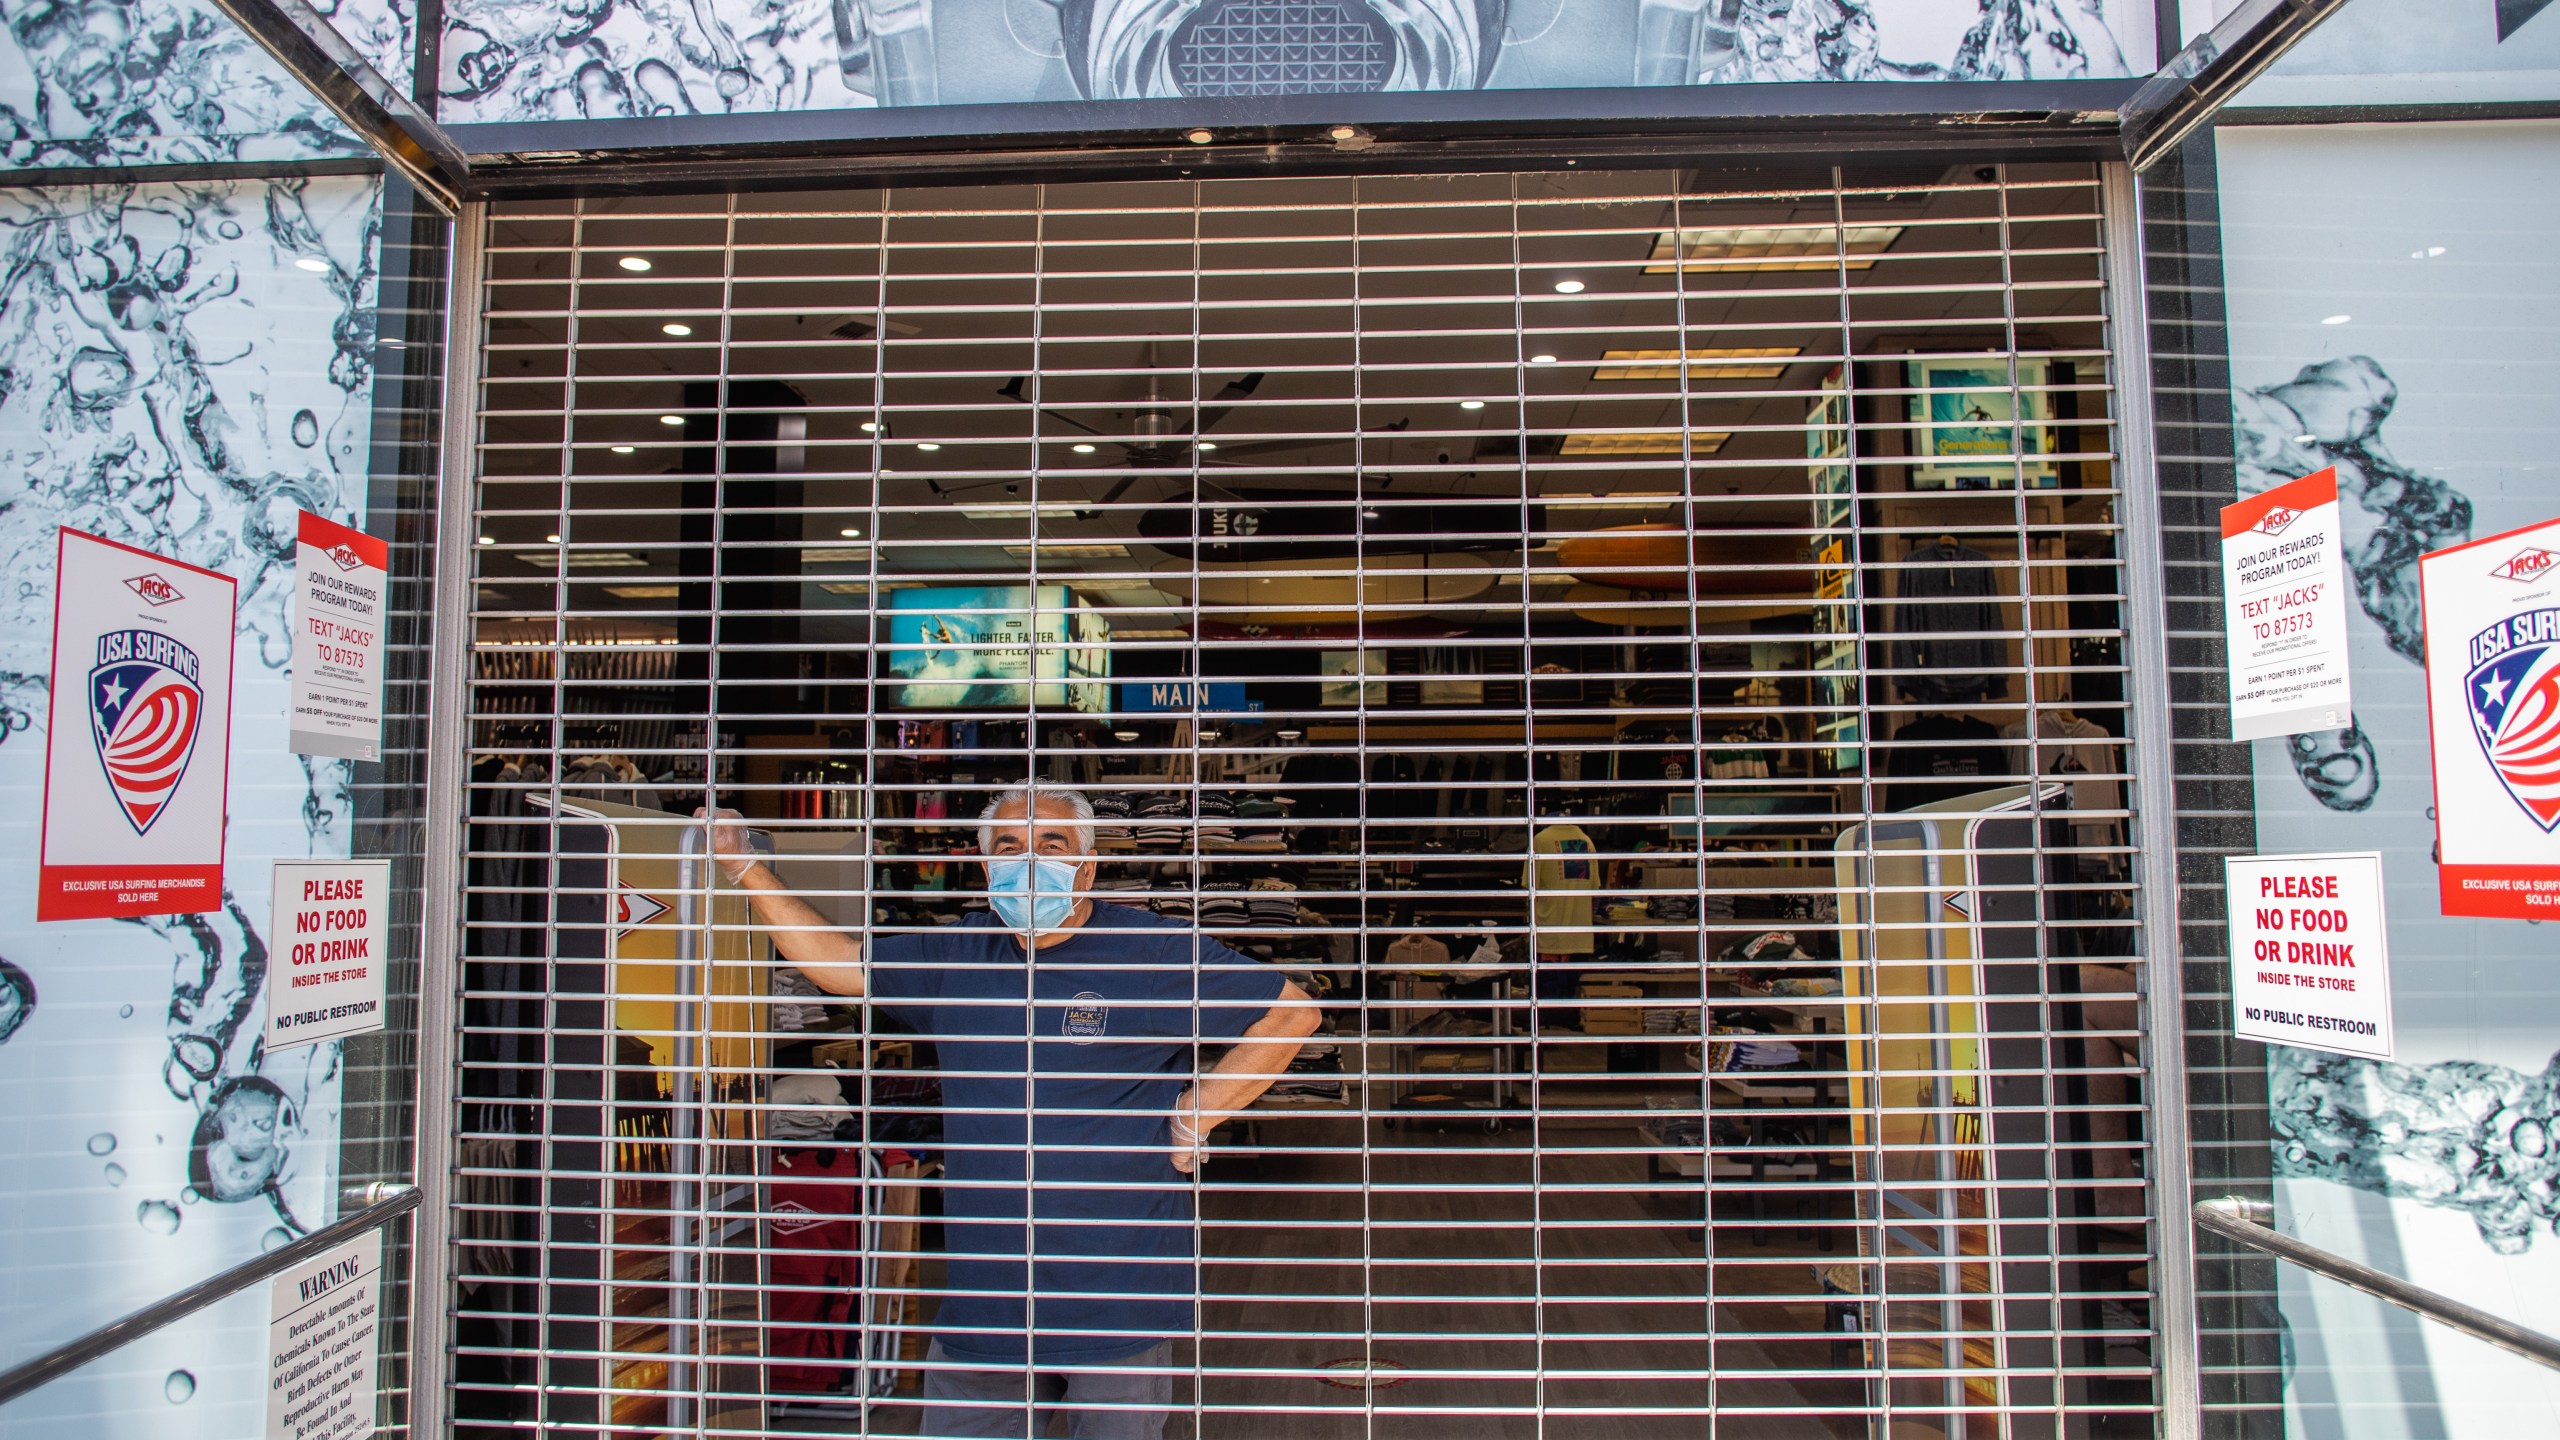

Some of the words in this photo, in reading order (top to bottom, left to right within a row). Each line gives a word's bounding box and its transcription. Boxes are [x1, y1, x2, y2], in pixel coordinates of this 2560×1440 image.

[2261, 509, 2291, 533] JACKS
[2236, 554, 2256, 570] JOIN
[2258, 547, 2277, 563] OUR
[2279, 532, 2324, 557] REWARDS
[2241, 562, 2284, 585] PROGRAM
[2286, 551, 2321, 572] TODAY!
[2507, 550, 2552, 579] JACKS
[139, 576, 170, 598] JACKS
[308, 570, 326, 586] JOIN
[327, 577, 343, 591] OUR
[344, 582, 377, 601] REWARDS
[311, 588, 347, 608] PROGRAM
[348, 599, 373, 616] TODAY!
[2240, 597, 2270, 619] TEXT
[308, 617, 334, 638] TEXT
[971, 632, 1014, 643] LIGHTER.
[2253, 622, 2270, 640] TO
[2274, 611, 2313, 636] 87573
[99, 631, 133, 665] USA
[135, 631, 198, 682] SURFING
[317, 643, 332, 661] TO
[334, 647, 364, 668] 87573
[1005, 648, 1054, 656] FLEXBLE.
[2471, 621, 2511, 667] USA
[2248, 676, 2263, 685] EARN
[2267, 670, 2285, 681] POINT
[2286, 668, 2297, 677] PER
[2298, 667, 2304, 675] $1
[2306, 663, 2325, 674] SPENT
[308, 692, 321, 701] EARN
[325, 695, 340, 703] POINT
[340, 698, 349, 706] PER
[355, 700, 368, 709] SPENT
[1152, 684, 1209, 706] MAIN
[1248, 703, 1259, 712] ST
[2247, 691, 2254, 699] $5
[2255, 689, 2266, 698] OFF
[2266, 688, 2278, 696] YOUR
[2279, 684, 2302, 694] PURCHASE
[2310, 681, 2319, 689] $20
[2327, 677, 2342, 686] MORE
[306, 707, 313, 715] $5
[313, 708, 323, 716] OFF
[333, 712, 351, 720] PURCHASE
[62, 880, 107, 891] EXCLUSIVE
[108, 880, 124, 890] USA
[125, 879, 157, 889] SURFING
[157, 878, 206, 888] MERCHANDISE
[303, 879, 364, 902] PLEASE
[2260, 875, 2339, 899] PLEASE
[2462, 879, 2510, 890] EXCLUSIVE
[2512, 880, 2532, 891] USA
[117, 893, 138, 903] SOLD
[139, 892, 159, 901] HERE
[2525, 894, 2552, 905] SOLD
[296, 911, 321, 934] NO
[325, 909, 367, 931] FOOD
[2256, 908, 2284, 931] NO
[2290, 908, 2348, 933] FOOD
[291, 943, 315, 966] OR
[320, 937, 369, 963] DRINK
[2254, 939, 2282, 963] OR
[2287, 941, 2356, 968] DRINK
[291, 973, 321, 988] INSIDE
[323, 971, 340, 984] THE
[341, 967, 367, 981] STORE
[2257, 971, 2291, 986] INSIDE
[2293, 974, 2315, 988] THE
[2318, 976, 2356, 992] STORE
[276, 1015, 292, 1030] NO
[293, 1008, 328, 1026] PUBLIC
[330, 1000, 377, 1020] RESTROOM
[1068, 1010, 1104, 1020] JACK'S
[2245, 1007, 2261, 1020] NO
[2263, 1009, 2305, 1027] PUBLIC
[2307, 1015, 2377, 1036] RESTROOM
[299, 1254, 360, 1303] WARNING
[289, 1309, 327, 1340] Detectable
[327, 1295, 356, 1319] Amounts
[356, 1286, 366, 1300] Of
[274, 1339, 311, 1369] Chemicals
[312, 1326, 336, 1346] Known
[337, 1319, 346, 1333] To
[347, 1313, 360, 1328] The
[360, 1303, 375, 1321] State
[273, 1376, 284, 1391] Of
[284, 1355, 320, 1385] California
[321, 1349, 331, 1363] To
[331, 1338, 351, 1357] Cause
[351, 1323, 374, 1344] Cancer,
[287, 1382, 306, 1404] Birth
[306, 1367, 333, 1392] Defects
[333, 1361, 343, 1373] Or
[343, 1350, 363, 1368] Other
[283, 1389, 330, 1428] Reproductive
[331, 1376, 350, 1396] Harm
[351, 1368, 365, 1386] May
[296, 1426, 306, 1440] Be
[307, 1407, 329, 1433] Found
[329, 1404, 338, 1418] In
[338, 1392, 352, 1414] And
